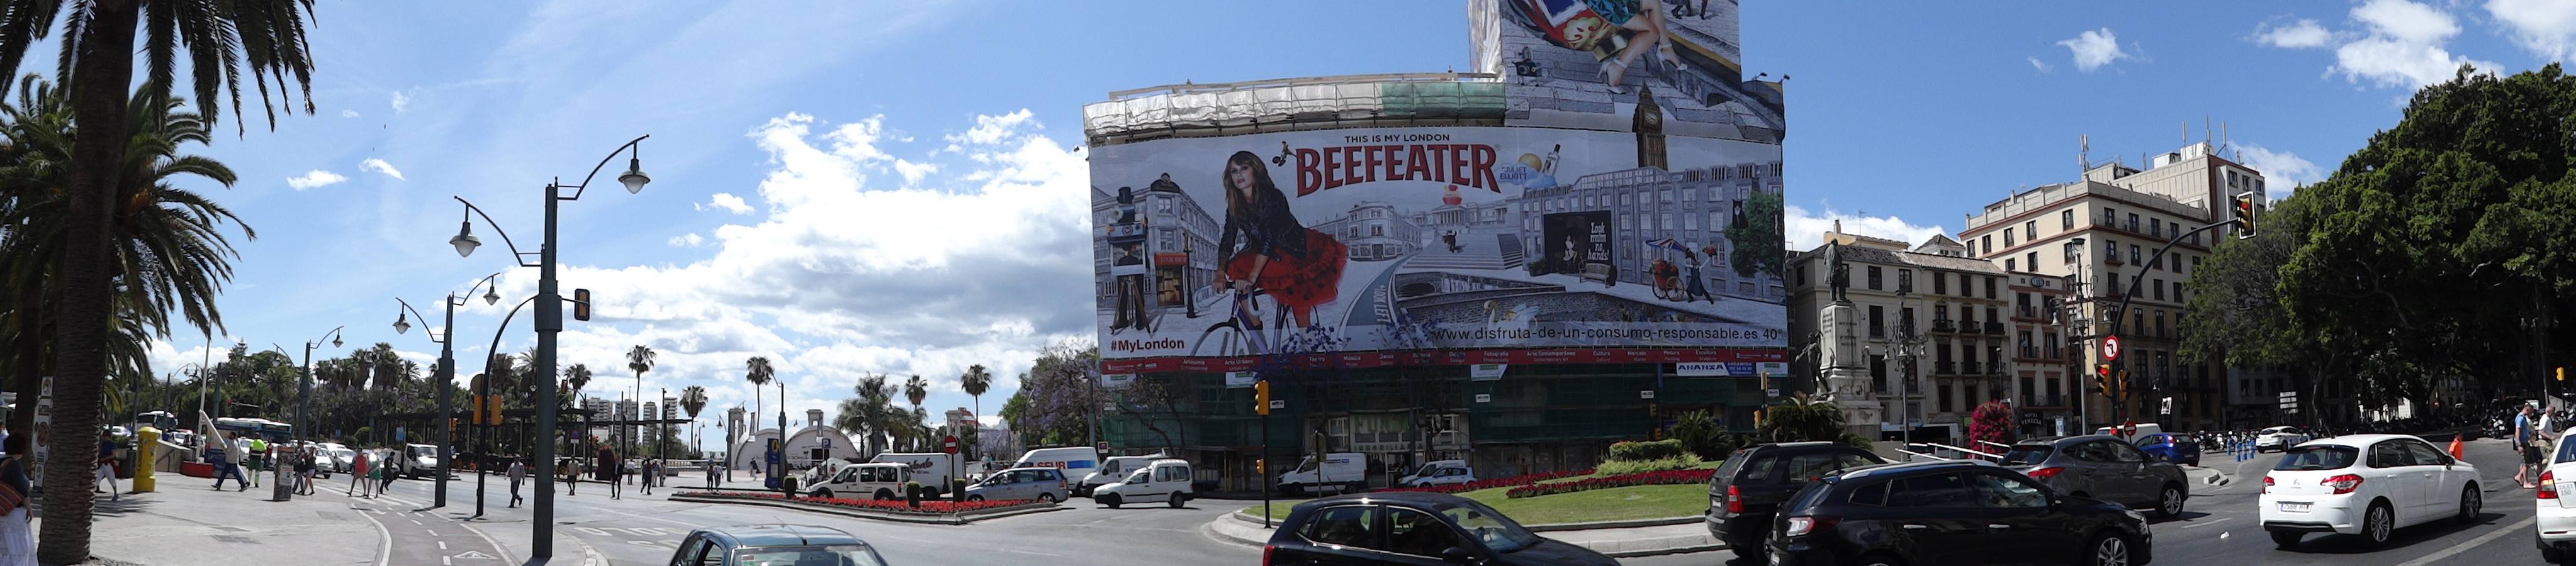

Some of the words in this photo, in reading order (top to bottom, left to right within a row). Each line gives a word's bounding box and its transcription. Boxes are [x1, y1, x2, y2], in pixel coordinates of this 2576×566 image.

[1295, 144, 1501, 198] BEEFEATER
[1432, 326, 1758, 340] www.disfruta-de-un-consumo-responsable.es
[1763, 328, 1783, 340] 40°
[1111, 338, 1184, 352] #MyLondon
